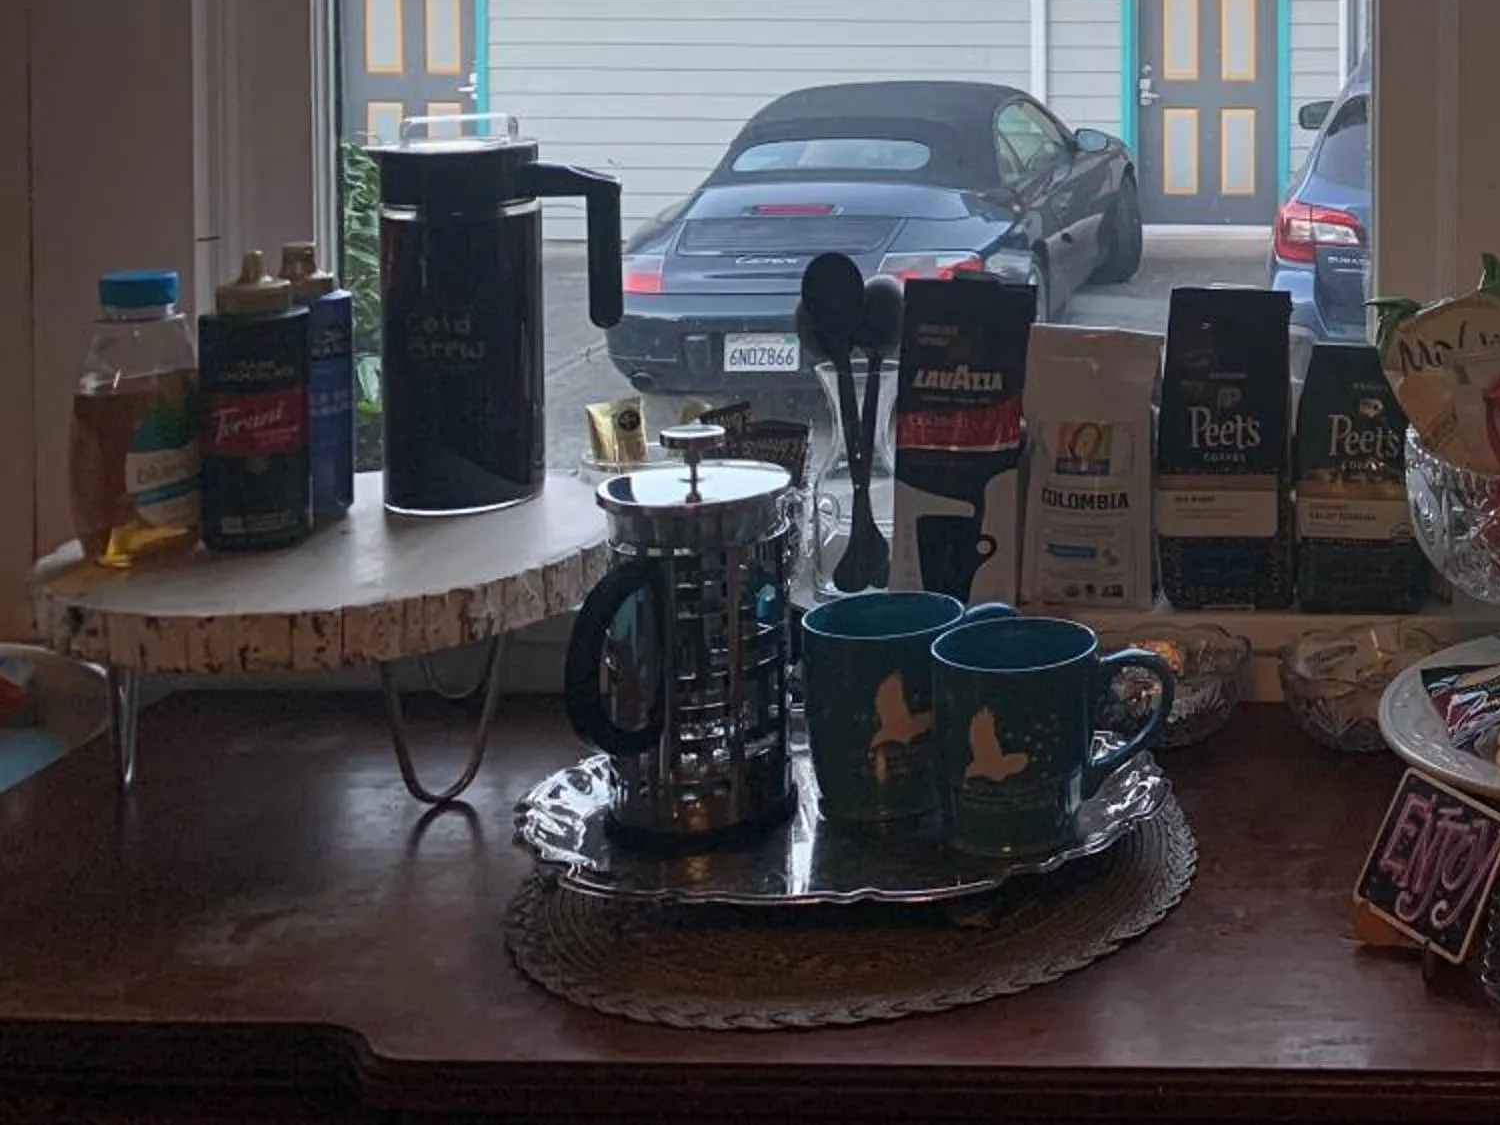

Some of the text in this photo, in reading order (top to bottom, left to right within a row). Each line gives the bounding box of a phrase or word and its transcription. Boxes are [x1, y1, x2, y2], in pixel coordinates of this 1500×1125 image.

[912, 363, 1003, 391] LAVAZZA
[1186, 404, 1262, 450] Peet's
[1326, 413, 1401, 460] Peet's
[1041, 487, 1130, 511] COLOMBIA
